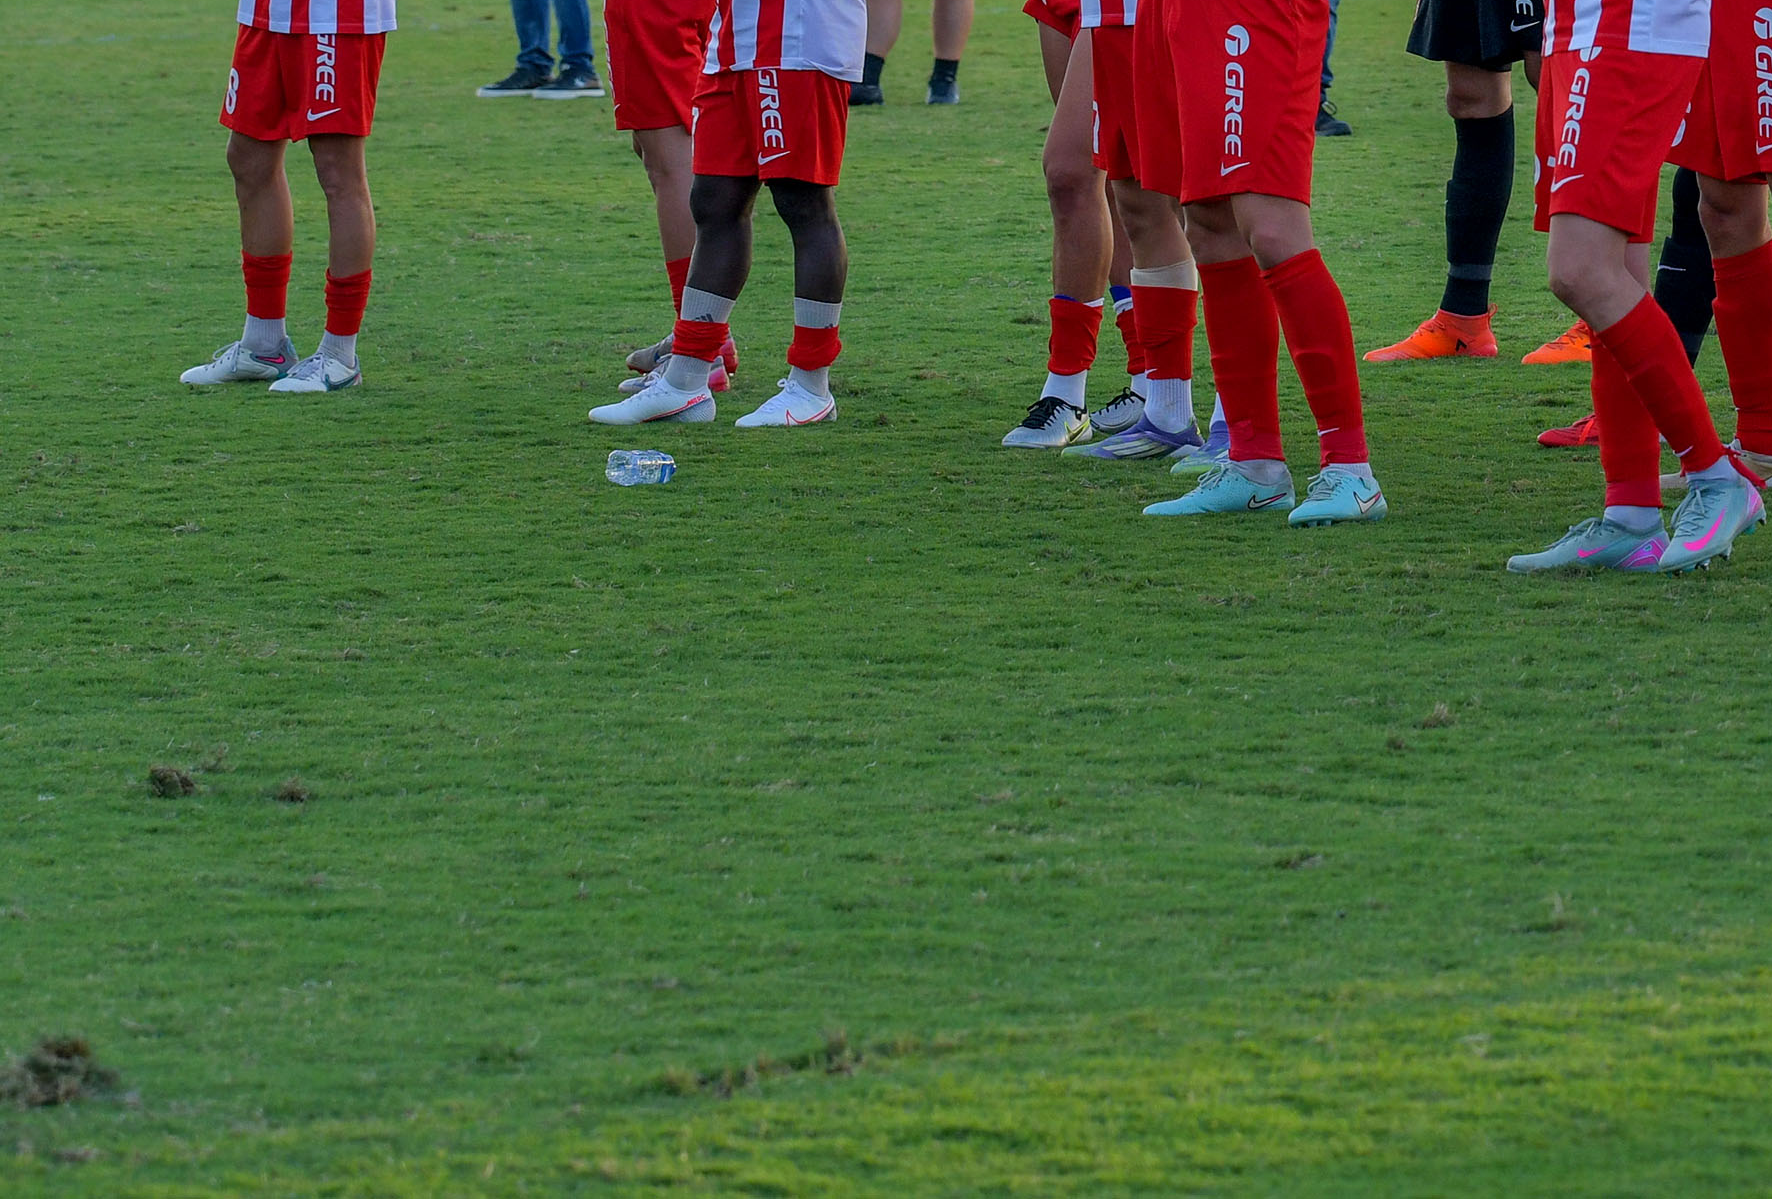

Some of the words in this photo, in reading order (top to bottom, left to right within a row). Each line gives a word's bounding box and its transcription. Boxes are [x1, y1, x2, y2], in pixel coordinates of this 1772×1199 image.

[758, 69, 785, 148] GREE
[1223, 61, 1245, 158] GREE
[1557, 67, 1590, 169] GREE
